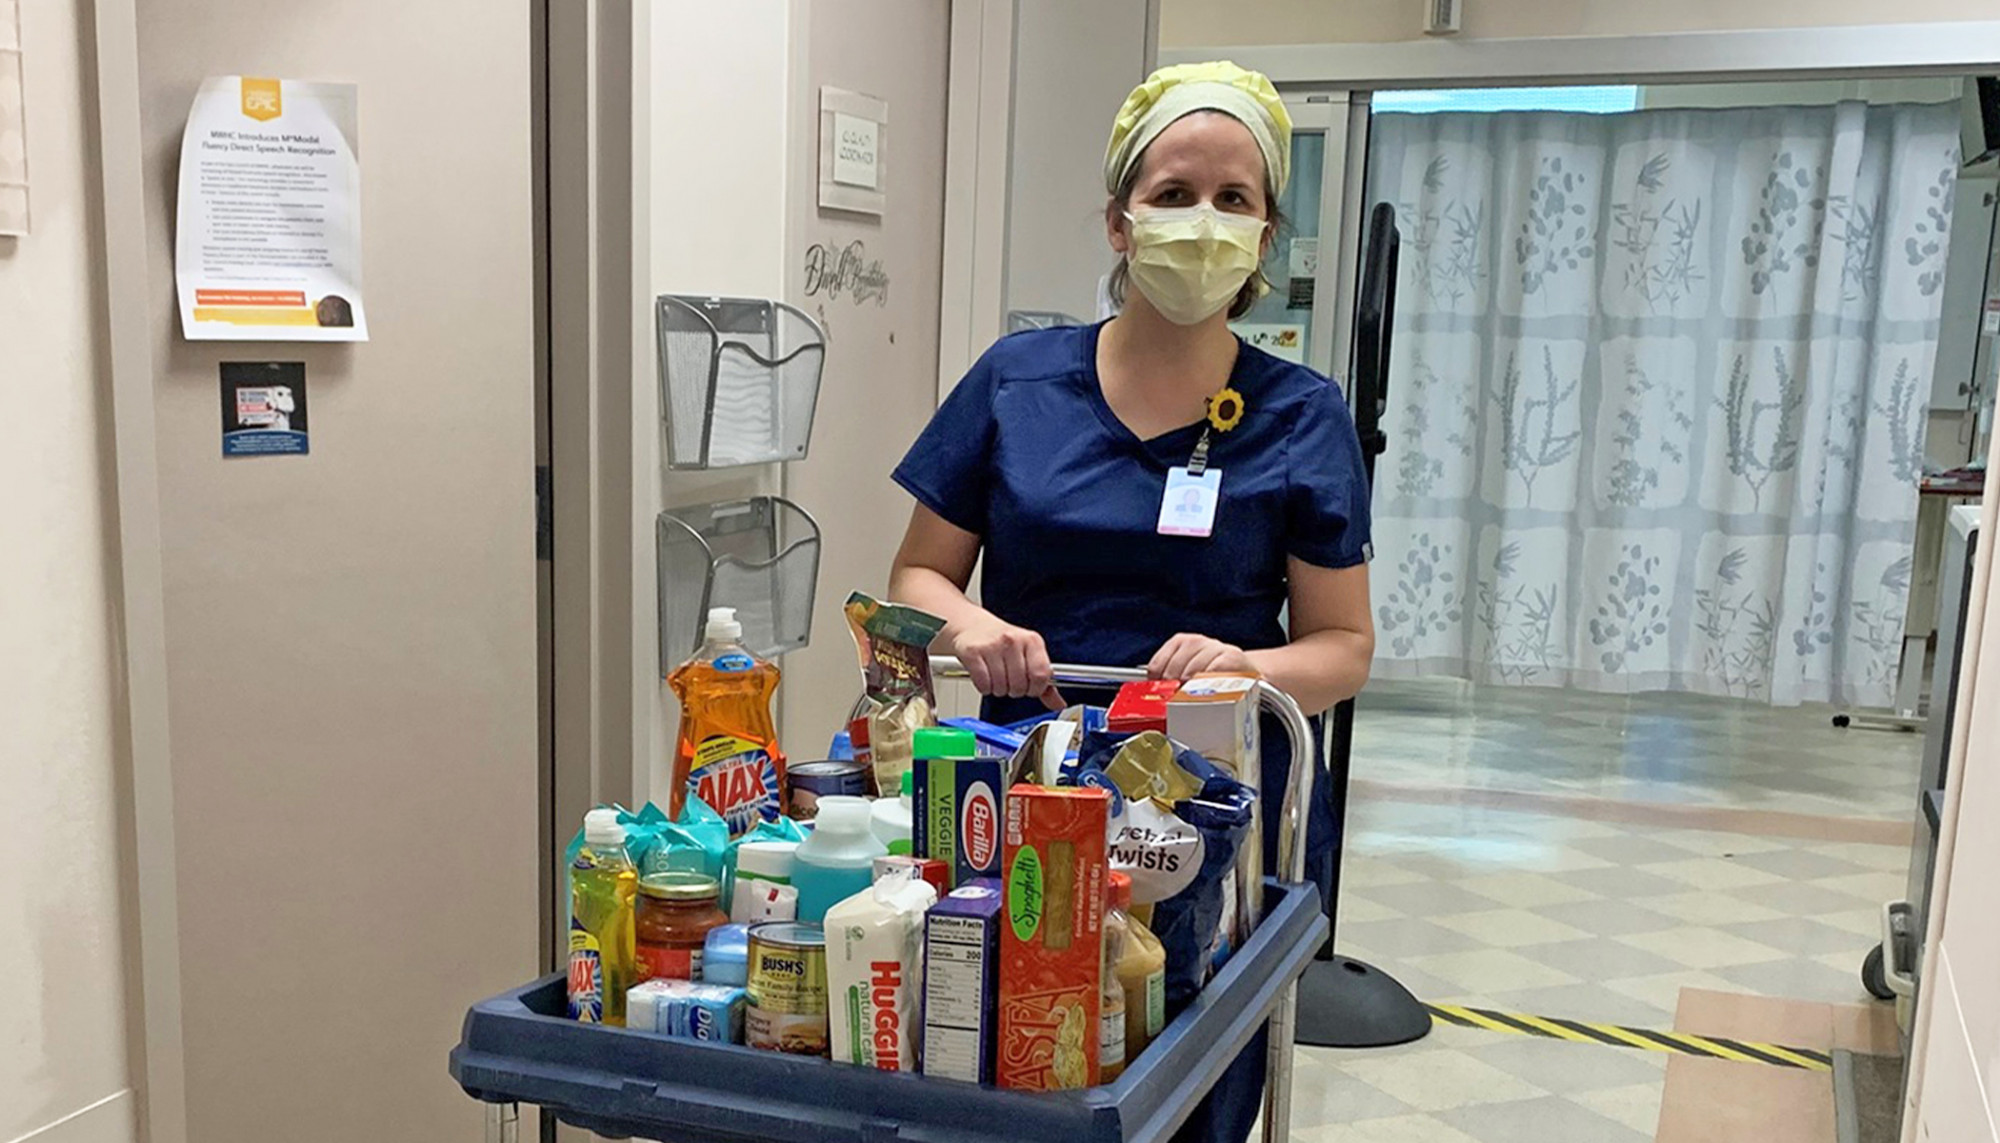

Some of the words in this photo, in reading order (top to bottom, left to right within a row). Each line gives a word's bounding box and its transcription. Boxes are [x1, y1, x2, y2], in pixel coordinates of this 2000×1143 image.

[202, 142, 228, 152] Fluency
[230, 143, 254, 151] Direct
[256, 145, 285, 155] Speech
[287, 146, 336, 157] Recognition
[238, 133, 279, 142] Introduces
[697, 758, 767, 817] AJAX
[939, 793, 952, 856] VEGGIE
[973, 801, 990, 863] Barilla
[1108, 844, 1180, 872] Twists
[1013, 857, 1042, 928] Spaghetti
[930, 917, 961, 926] Nutrition
[962, 920, 982, 929] Facts
[762, 956, 804, 976] BUSH'S
[966, 950, 981, 960] 200
[767, 981, 793, 993] Family
[859, 981, 873, 1033] natural
